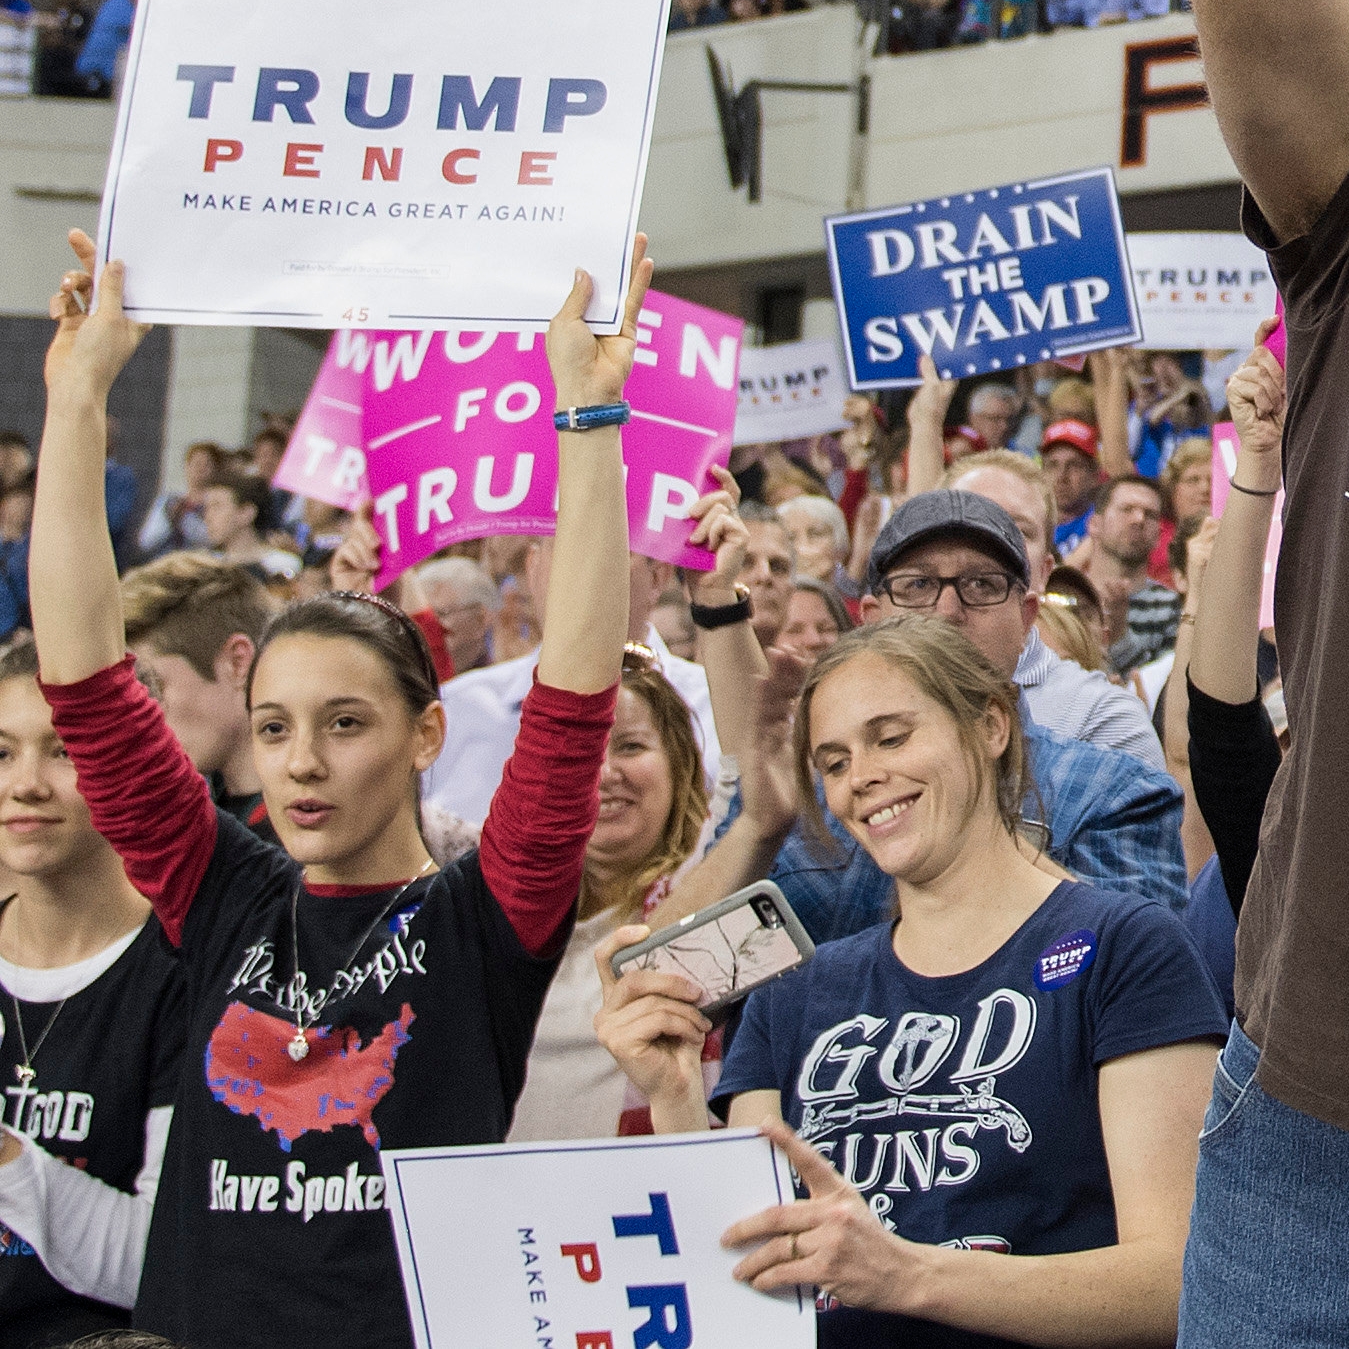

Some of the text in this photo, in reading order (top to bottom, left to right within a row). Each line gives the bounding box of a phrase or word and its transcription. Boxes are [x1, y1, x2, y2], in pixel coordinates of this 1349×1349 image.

[176, 64, 608, 133] TRUMP
[203, 138, 558, 186] PENCE
[183, 193, 565, 222] MAKE AMERICA GREAT AGAIN!
[866, 196, 1082, 277] DRAIN
[942, 257, 1024, 299] THE
[1136, 268, 1267, 286] TRUMP
[1146, 291, 1253, 302] PENCE
[864, 276, 1110, 363] SWAMP
[373, 305, 738, 392] WOEN
[740, 365, 829, 392] RUMP
[453, 381, 541, 432] FO
[376, 453, 700, 552] TRUP
[1042, 946, 1091, 965] TRUMP
[798, 988, 1036, 1103] GOD
[27, 1091, 94, 1141] GOD
[209, 1158, 279, 1212] Have
[869, 1193, 897, 1233] &
[517, 1227, 547, 1304] MAKE
